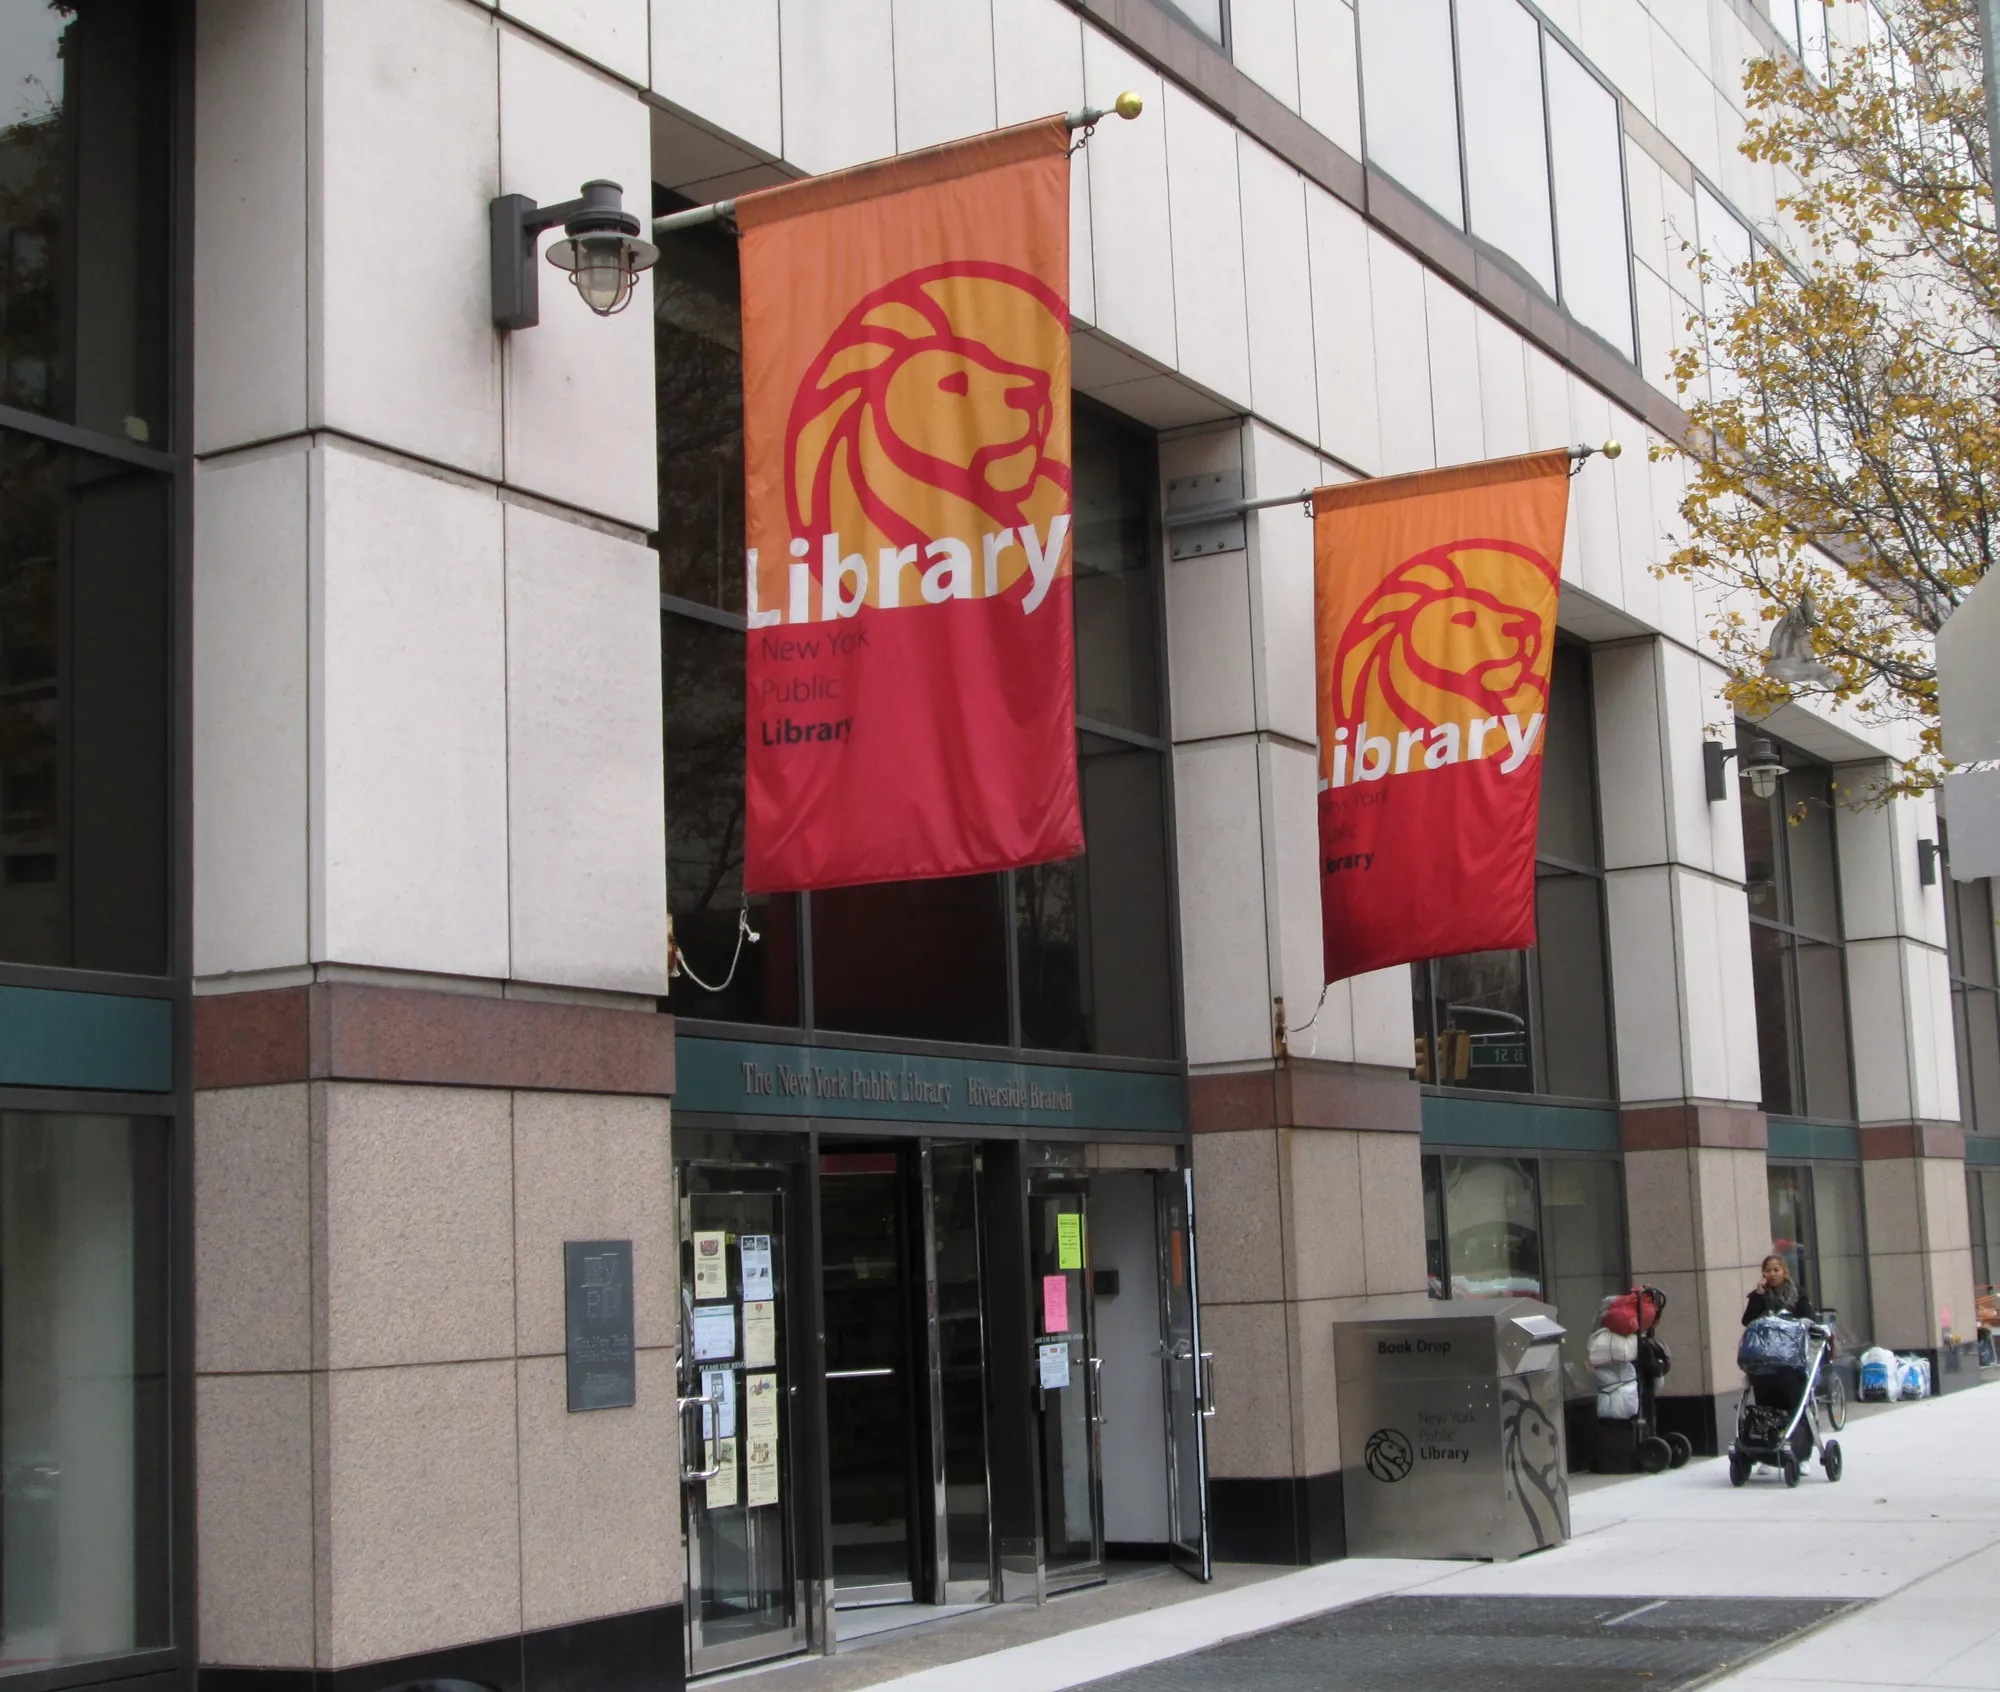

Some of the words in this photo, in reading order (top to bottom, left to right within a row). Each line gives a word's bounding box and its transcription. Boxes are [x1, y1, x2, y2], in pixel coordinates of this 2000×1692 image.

[747, 513, 1071, 629] Library
[761, 637, 820, 663] New
[828, 627, 870, 655] Yok
[761, 675, 841, 706] Public
[761, 717, 853, 746] Library
[1326, 852, 1375, 874] brary
[742, 1062, 773, 1096] The
[776, 1064, 810, 1097] New
[812, 1066, 847, 1100] York
[851, 1069, 897, 1102] Public
[898, 1072, 952, 1112] Library
[967, 1077, 1027, 1109] Riverside
[1029, 1080, 1073, 1112] Branch
[1378, 1339, 1412, 1354] Book
[1417, 1339, 1451, 1356] Drop
[1418, 1411, 1445, 1425] New
[1450, 1410, 1477, 1424] York
[1419, 1428, 1456, 1442] Public
[1420, 1445, 1469, 1463] Library
